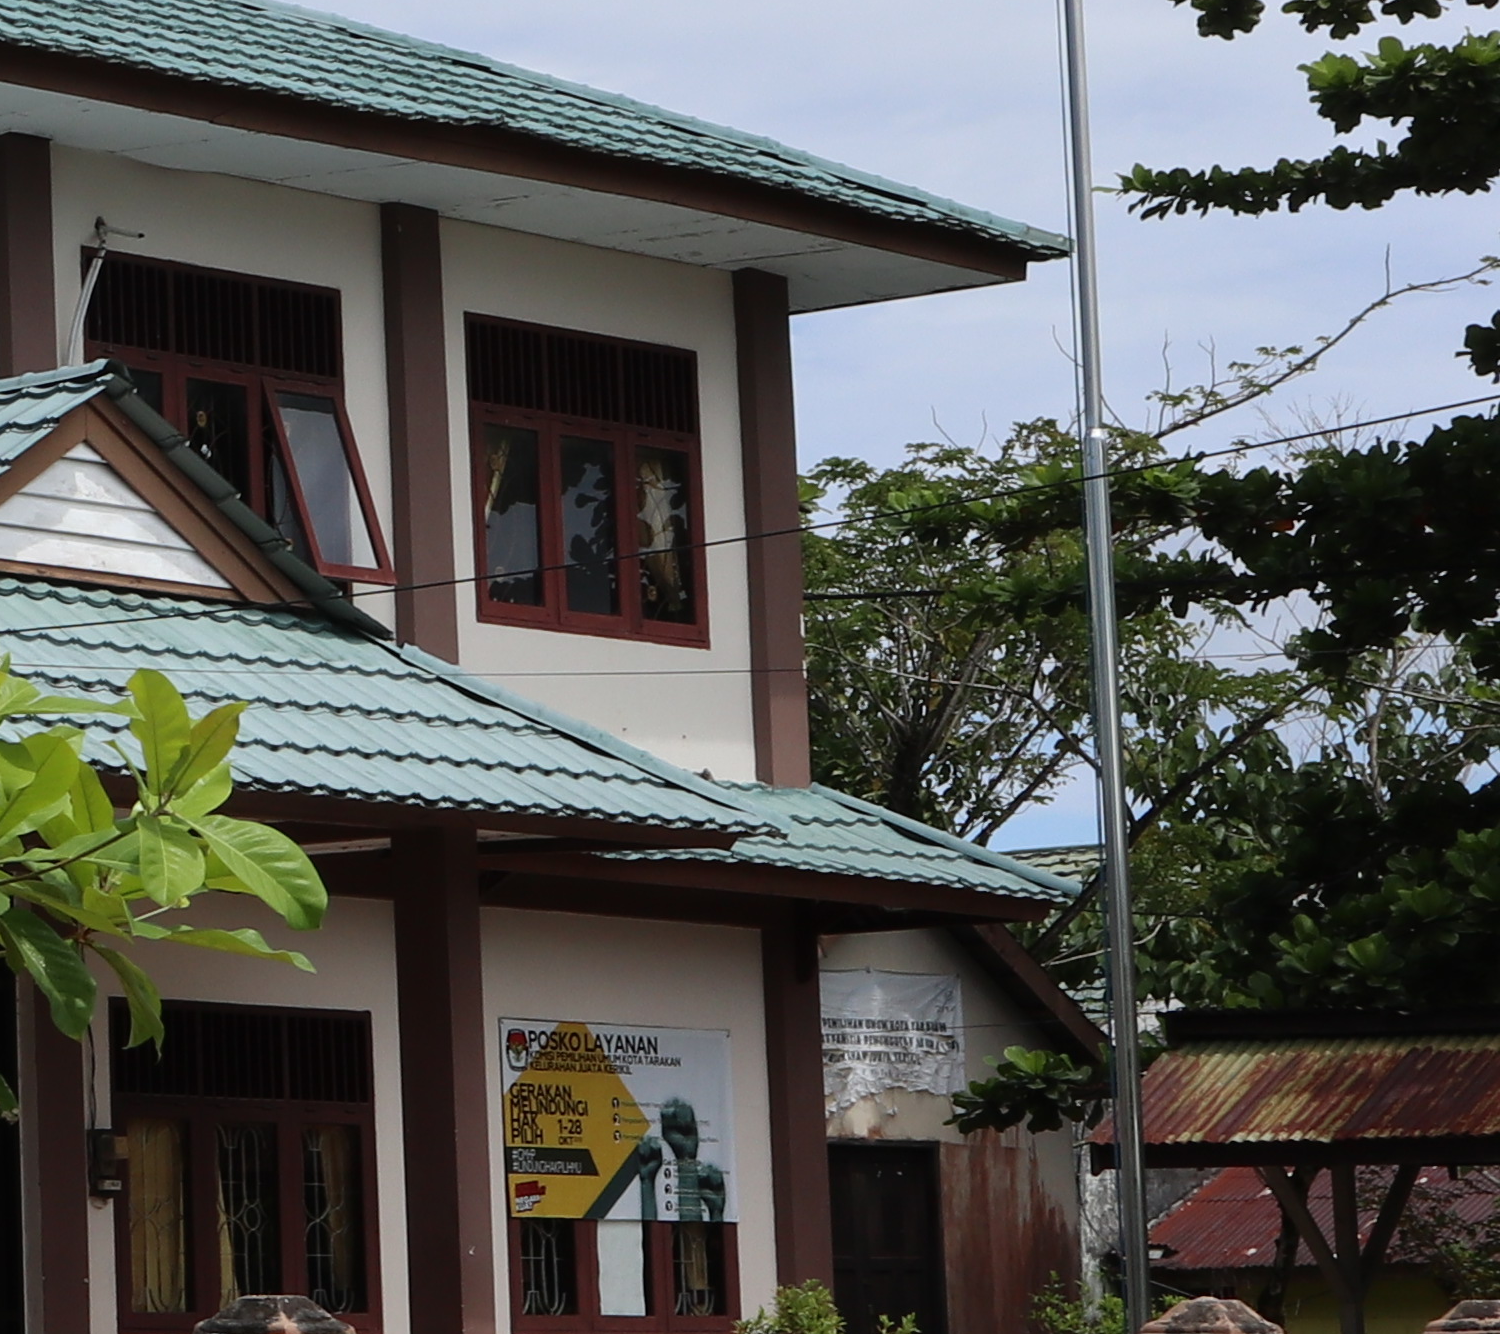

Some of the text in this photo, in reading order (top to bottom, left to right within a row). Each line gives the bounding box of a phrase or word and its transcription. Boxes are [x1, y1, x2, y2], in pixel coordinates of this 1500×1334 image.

[528, 1030, 658, 1055] POSKO LAYANAN
[556, 1051, 596, 1062] PEMILIHAN
[623, 1055, 643, 1065] KOTA
[644, 1056, 681, 1067] TARAKAN
[510, 1082, 572, 1100] GERAKAN
[510, 1097, 588, 1117] MELINDUNGI
[511, 1111, 583, 1135] HAK 1-28
[511, 1127, 544, 1145] PILIH
